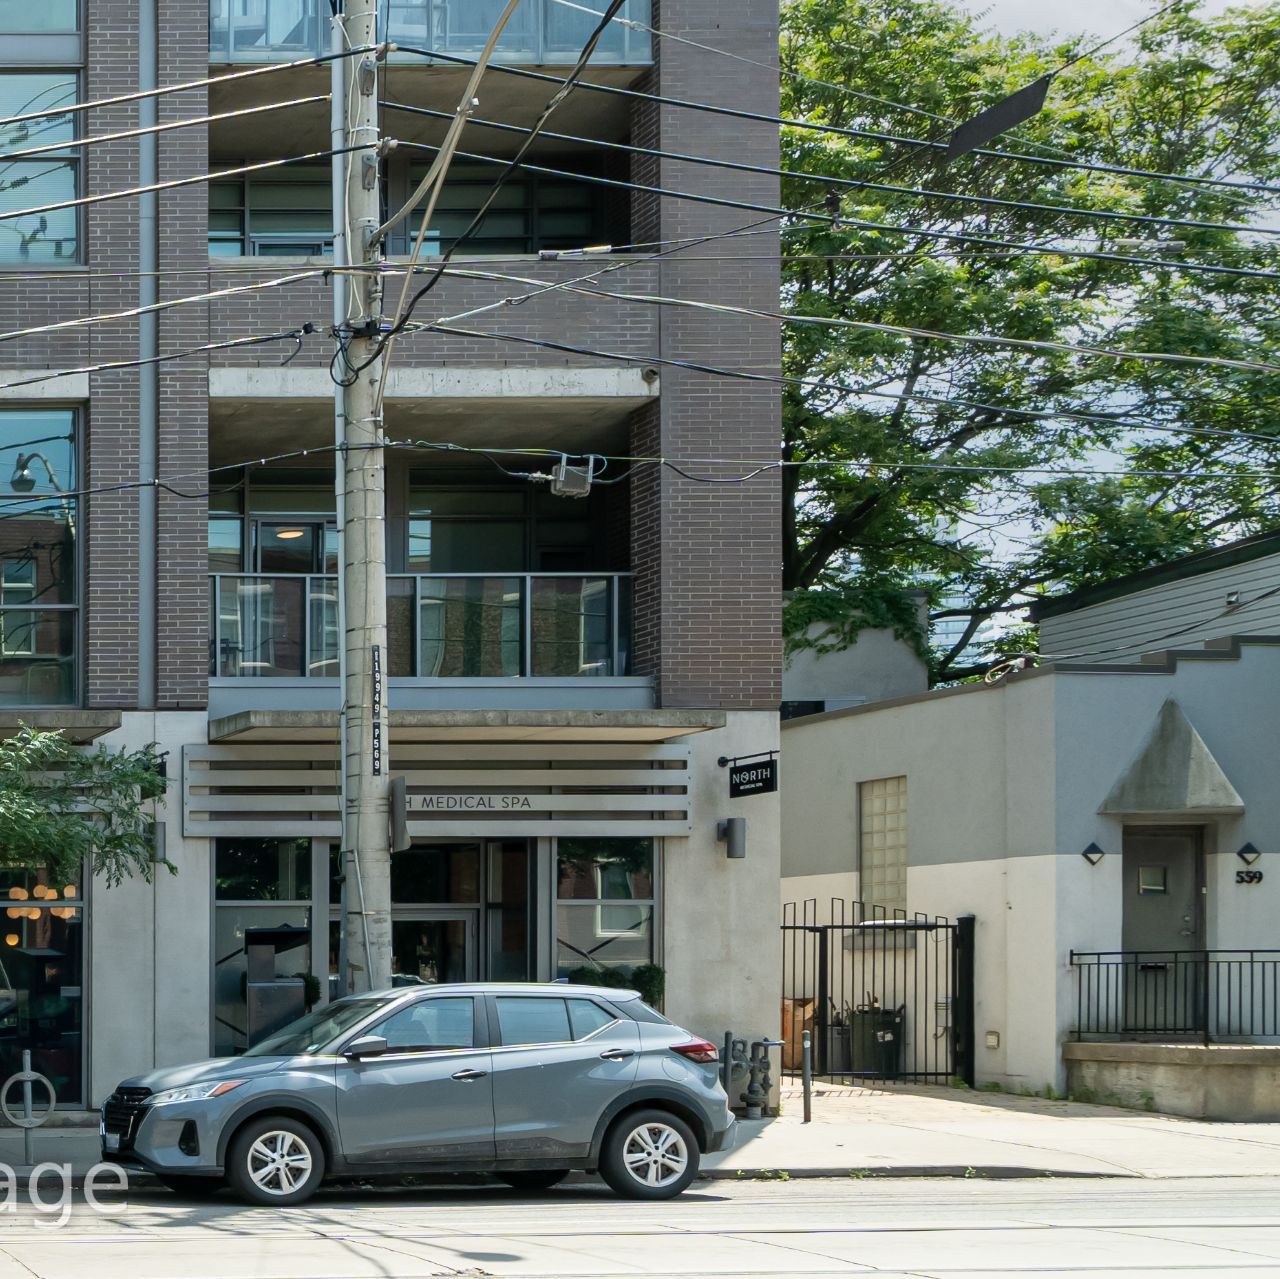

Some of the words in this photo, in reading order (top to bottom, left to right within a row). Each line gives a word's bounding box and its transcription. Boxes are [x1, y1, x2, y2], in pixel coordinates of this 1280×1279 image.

[373, 729, 381, 770] P569
[732, 767, 770, 784] NORTH
[421, 796, 496, 809] MEDICAL
[501, 796, 532, 809] SPA
[1235, 870, 1264, 884] 559
